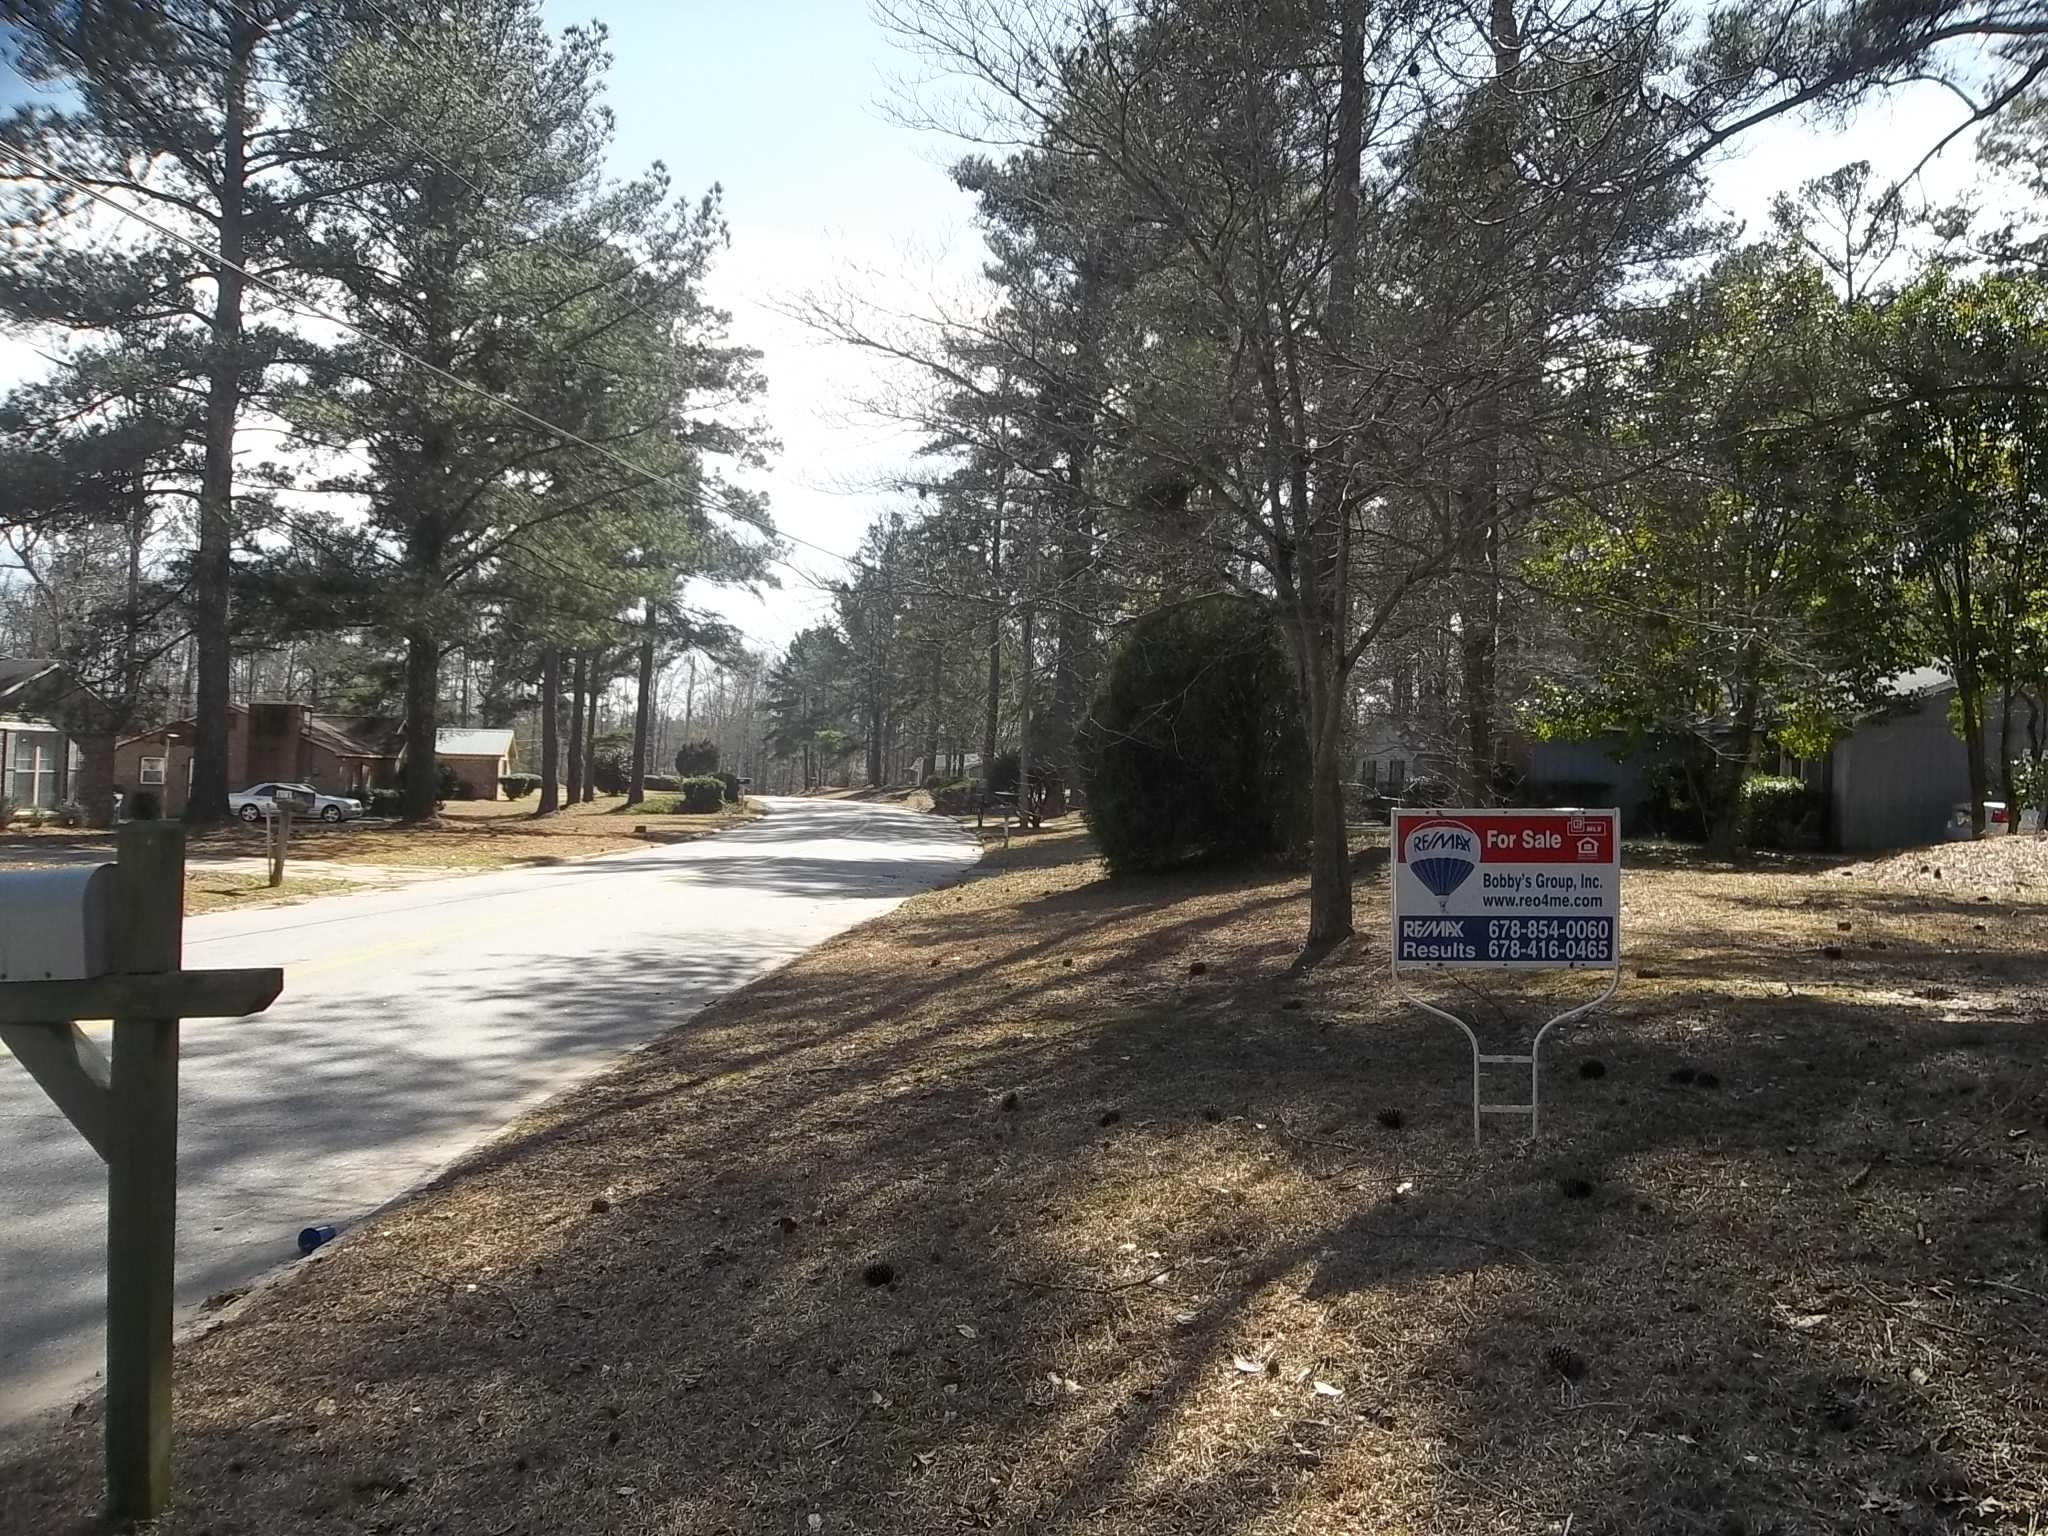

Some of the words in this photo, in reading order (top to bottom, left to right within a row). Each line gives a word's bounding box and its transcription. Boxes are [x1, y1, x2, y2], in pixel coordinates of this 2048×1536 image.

[1413, 831, 1471, 852] RE/MAX
[1487, 830, 1516, 849] For
[1522, 830, 1562, 849] Sale
[1483, 873, 1532, 892] Bobby's
[1535, 874, 1577, 893] Group,
[1580, 873, 1603, 889] Inc.
[1482, 894, 1603, 908] www.reo4me.com
[1403, 920, 1465, 938] RE/MAX
[1488, 920, 1609, 939] 678-854-0060
[1403, 941, 1476, 959] Results
[1488, 940, 1609, 959] 678-416-0465
